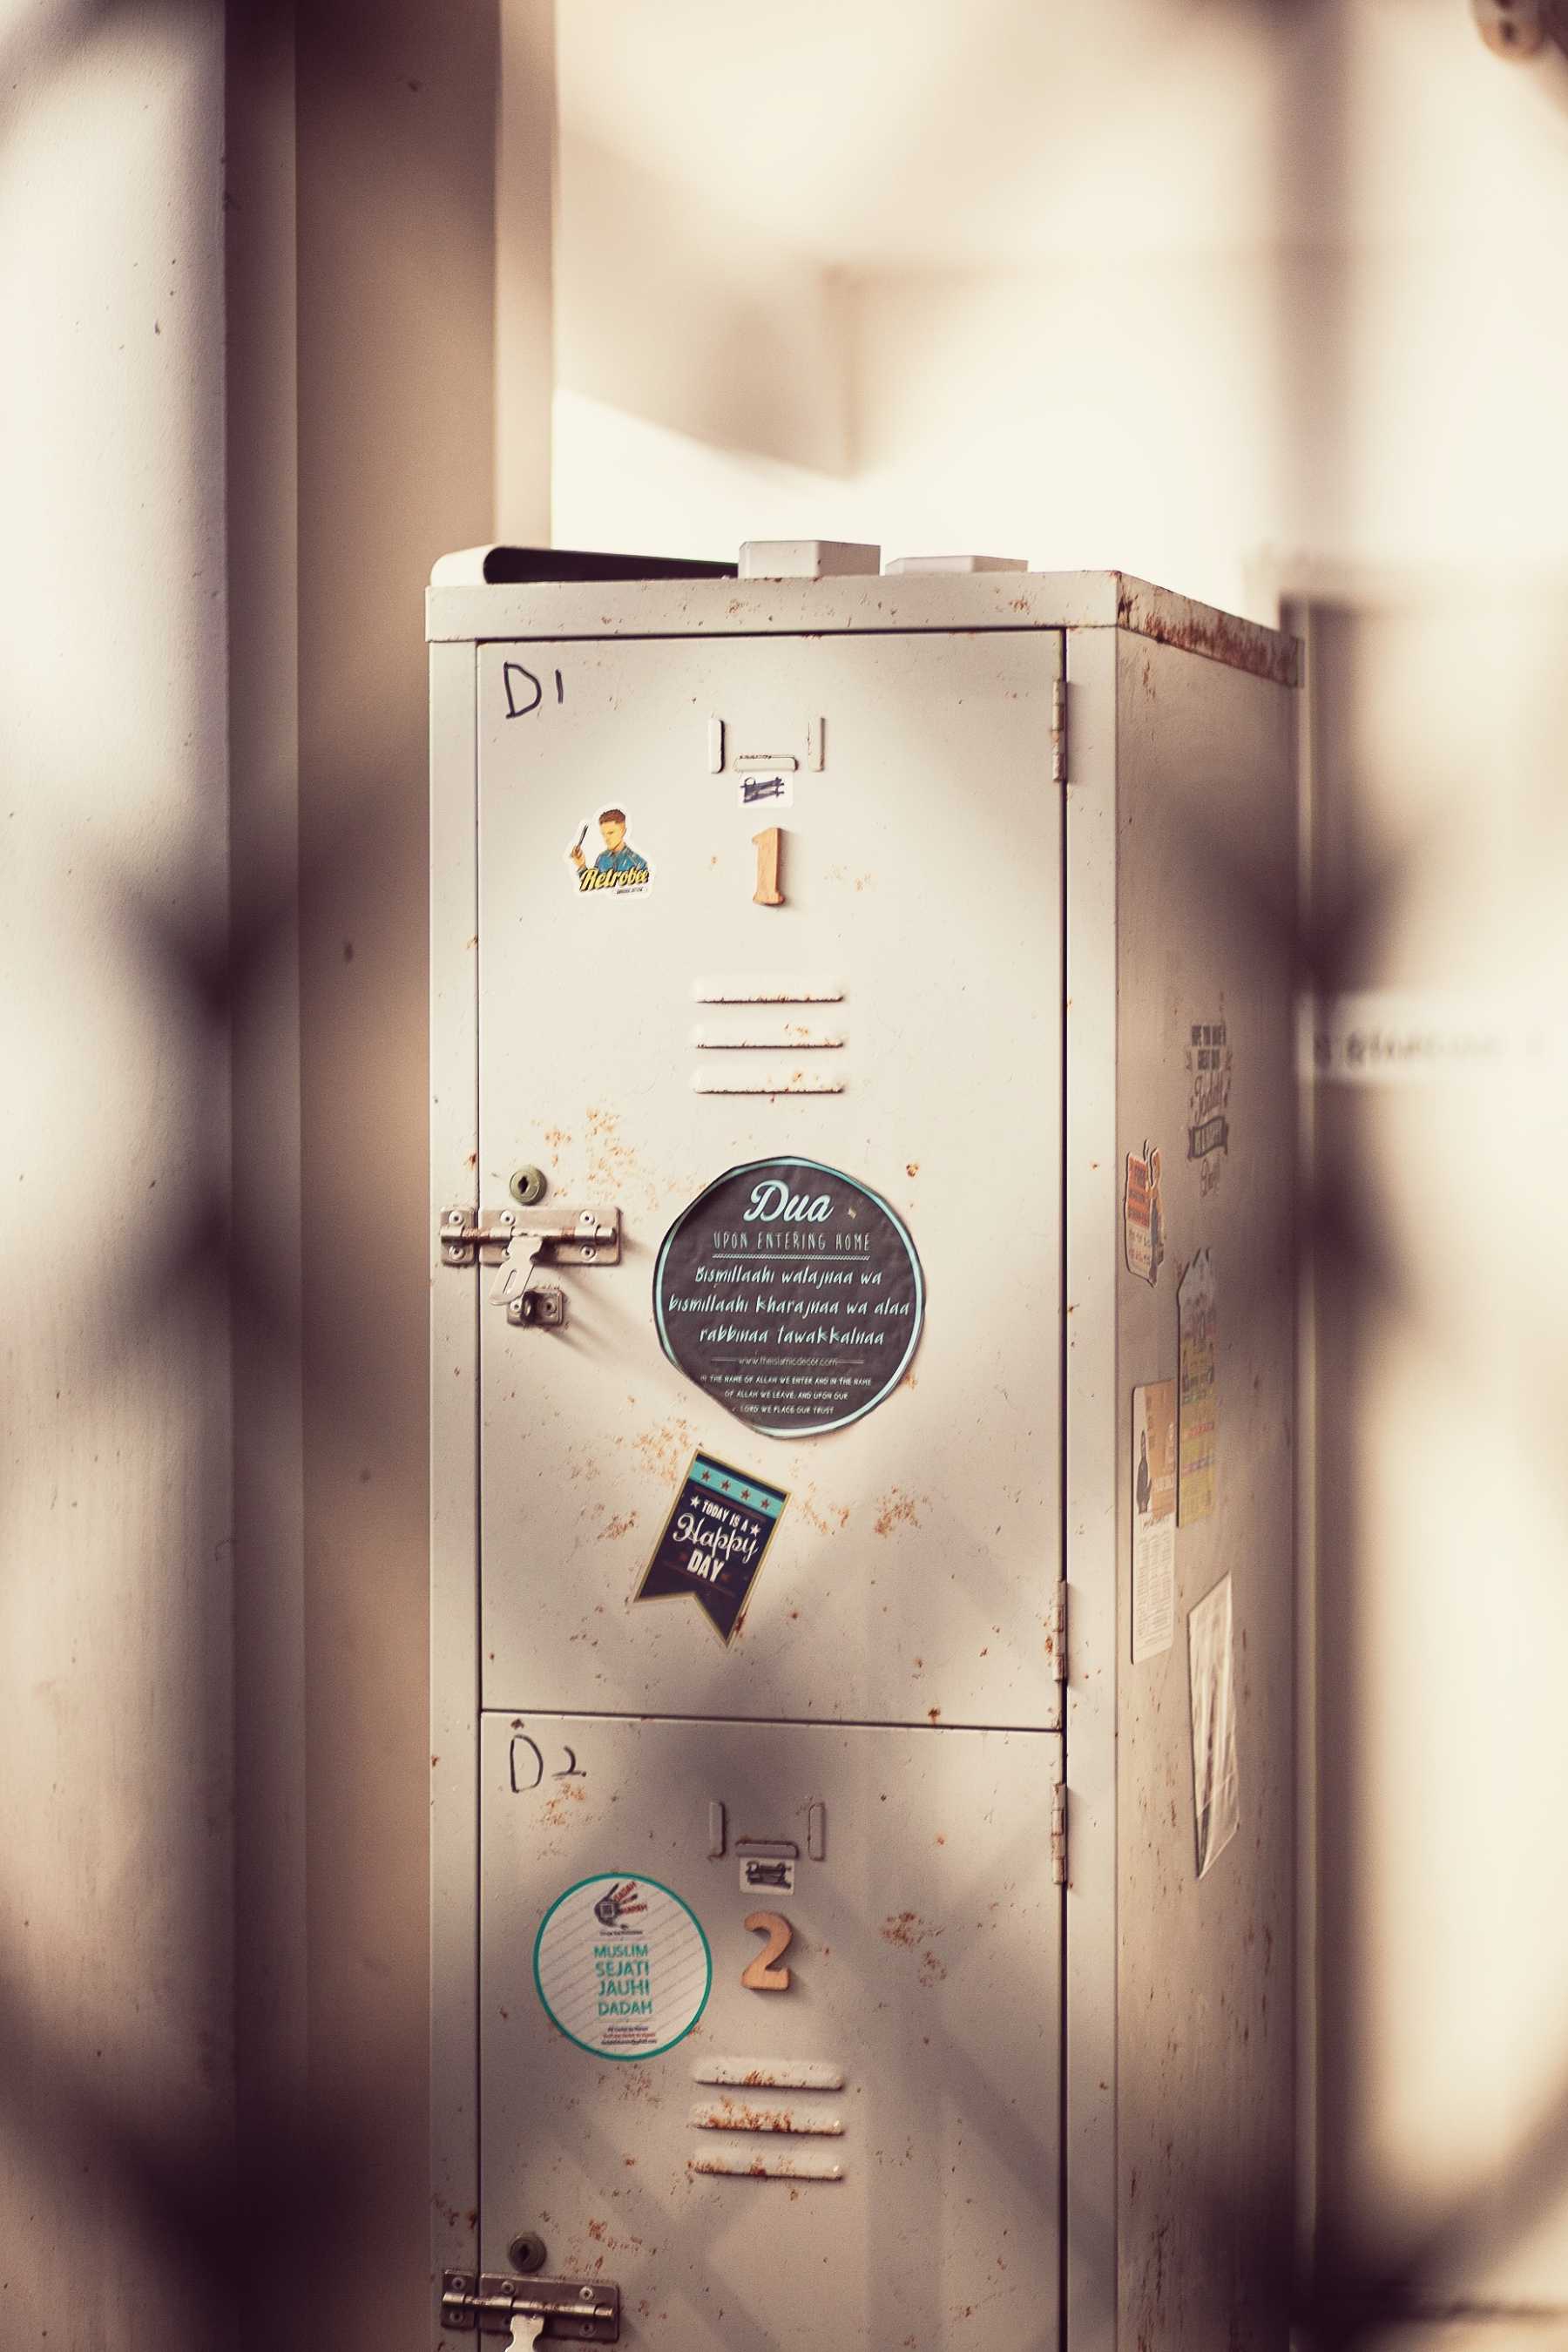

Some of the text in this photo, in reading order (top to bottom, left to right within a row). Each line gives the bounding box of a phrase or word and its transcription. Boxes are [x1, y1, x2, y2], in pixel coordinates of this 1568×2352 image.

[752, 828, 785, 905] 1
[743, 1179, 834, 1222] Dua
[713, 1231, 870, 1251] UPON ENTERING HOME
[861, 1272, 882, 1285] wa
[847, 1301, 868, 1315] wa
[874, 1297, 909, 1315] alaa
[710, 1374, 723, 1383] THE
[724, 1375, 742, 1384] NAME
[755, 1375, 778, 1384] ALLAH
[791, 1375, 813, 1385] ENTER
[702, 1499, 748, 1532] TODAY IS A
[672, 1512, 759, 1564] Happy
[686, 1548, 725, 1583] DAY
[510, 1734, 586, 1794] D2
[593, 1943, 648, 1958] MUSLIM
[743, 1912, 794, 1991] 2
[595, 1961, 649, 1977] SEJATI
[598, 1979, 650, 1996] JAUHI
[598, 2000, 652, 2016] DADAH
